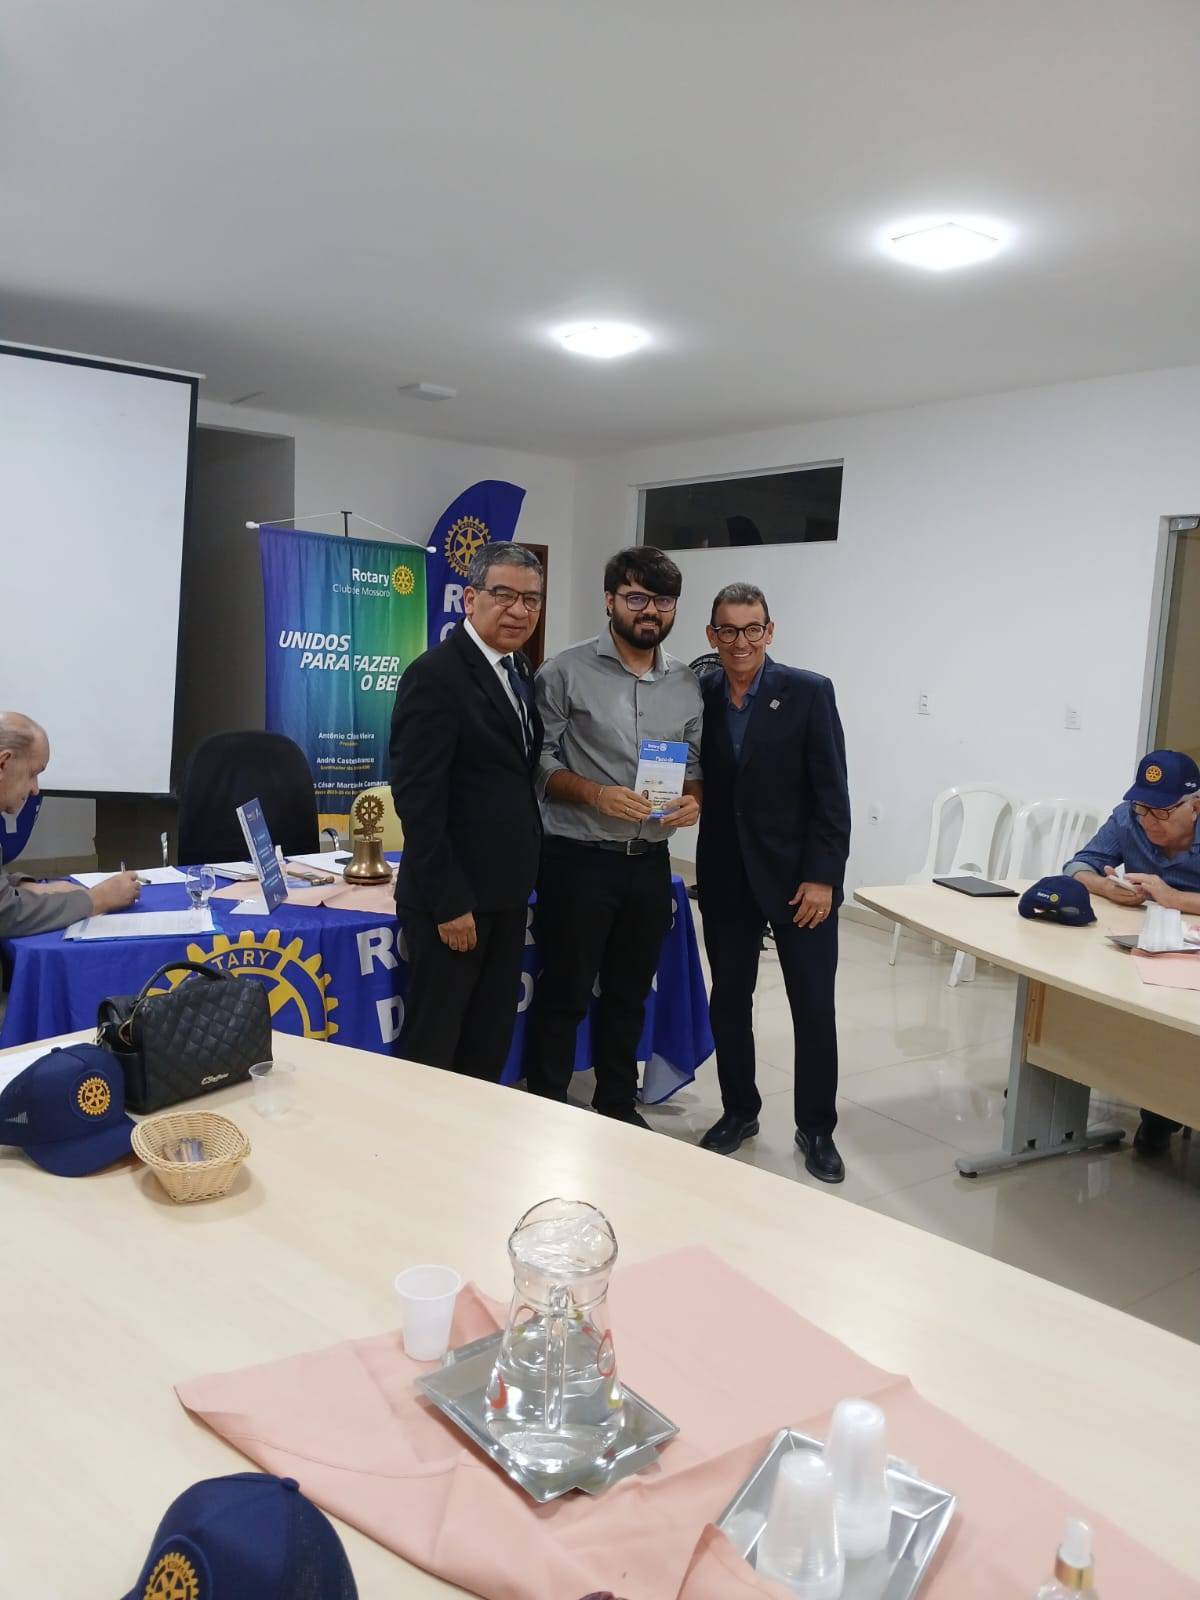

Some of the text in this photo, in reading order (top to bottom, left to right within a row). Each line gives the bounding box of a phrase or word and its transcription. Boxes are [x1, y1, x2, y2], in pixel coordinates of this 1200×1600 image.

[352, 568, 389, 586] Rotary
[332, 583, 351, 594] Club
[279, 631, 351, 652] UNIDOS
[300, 651, 400, 673] PARA FAZER
[361, 674, 401, 691] O BE
[318, 732, 345, 740] Antônio
